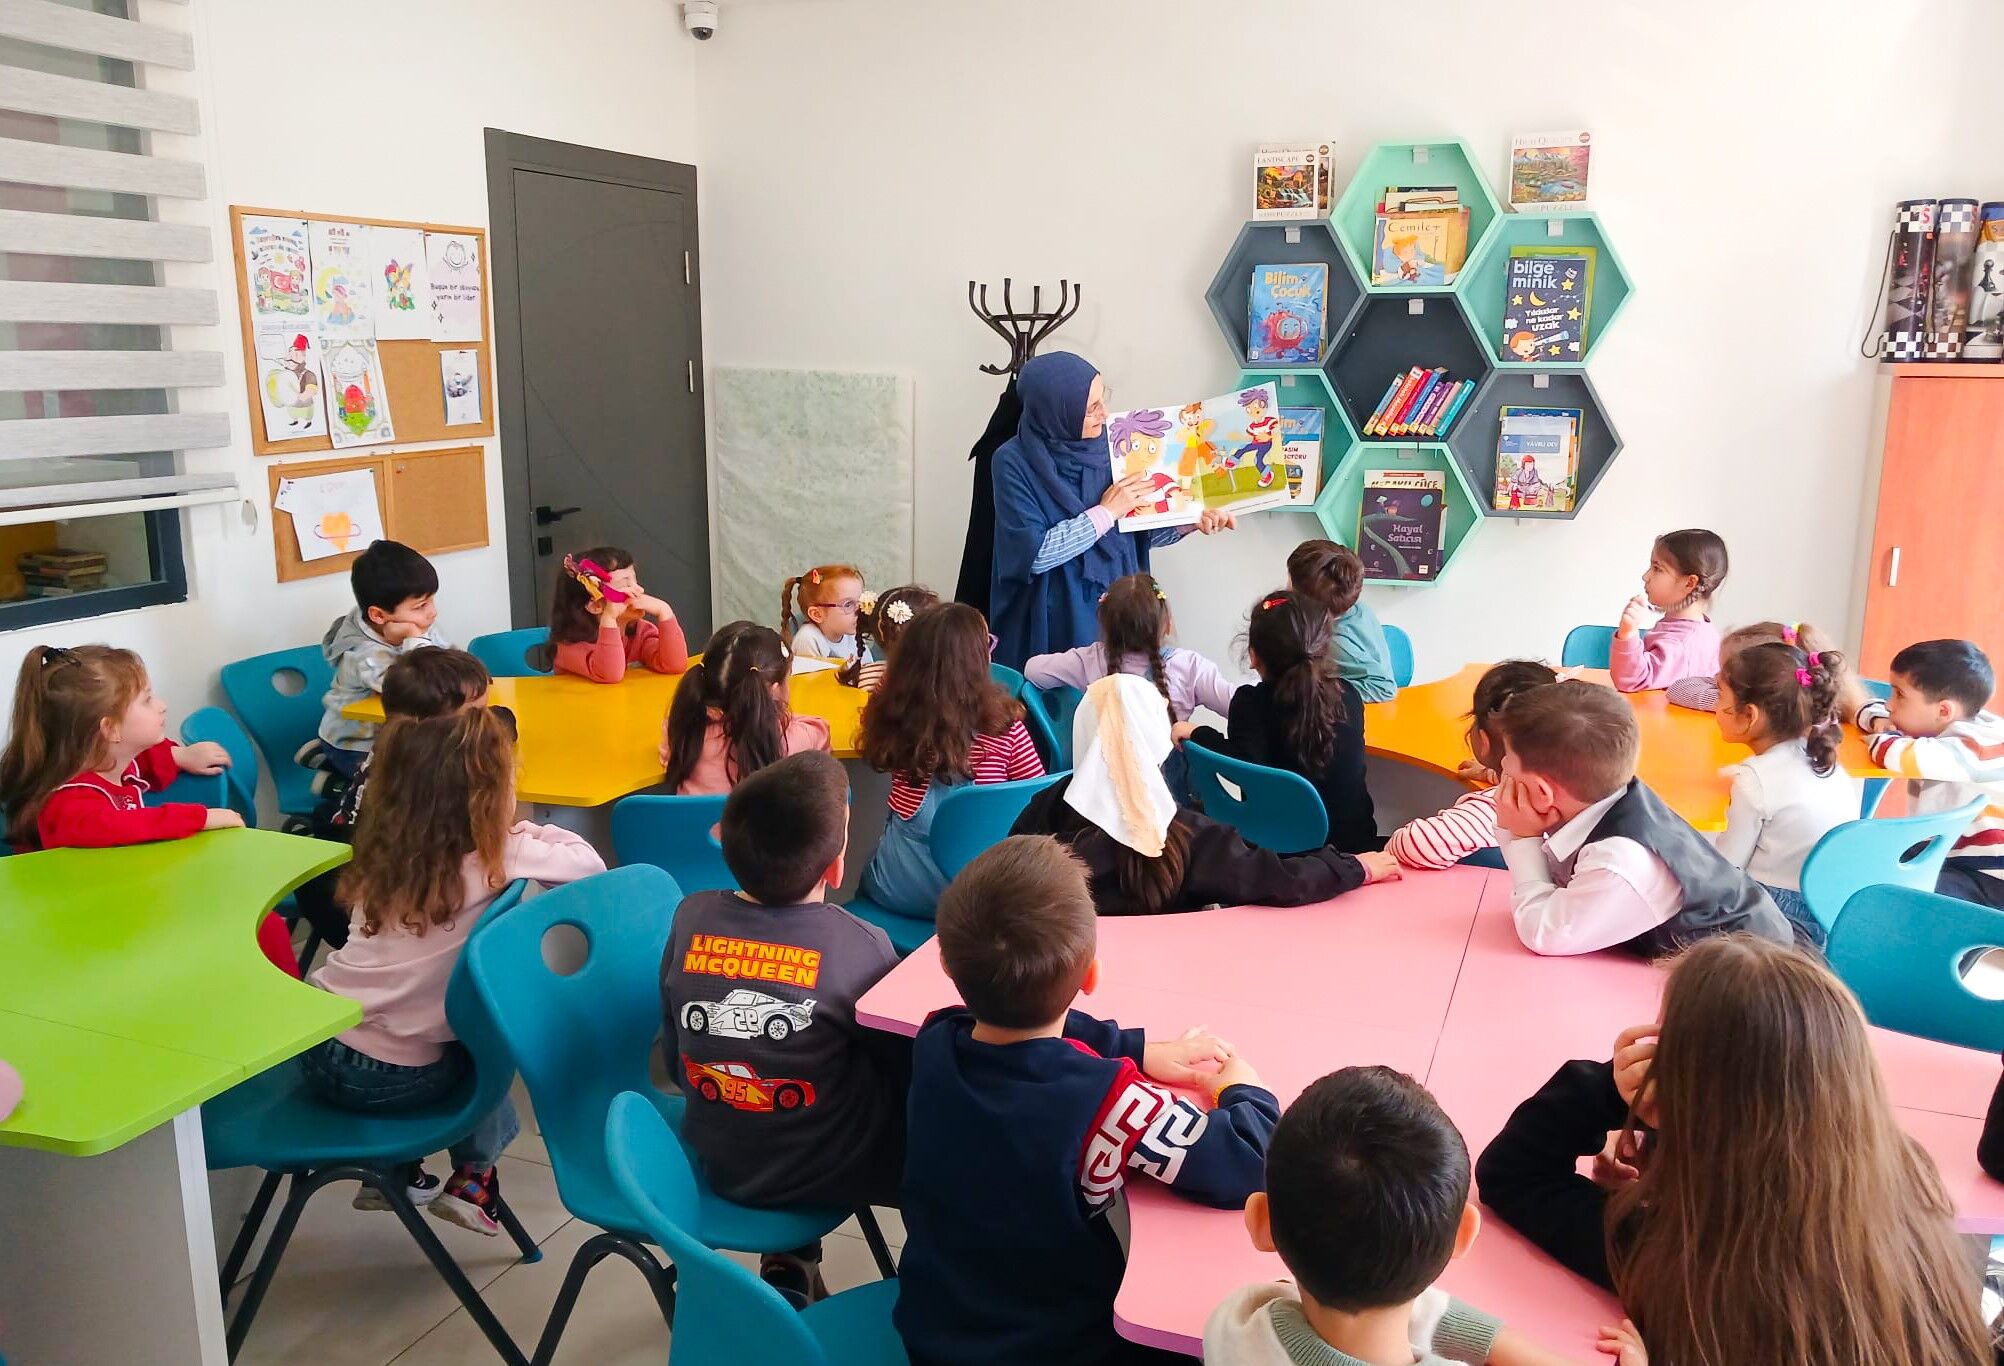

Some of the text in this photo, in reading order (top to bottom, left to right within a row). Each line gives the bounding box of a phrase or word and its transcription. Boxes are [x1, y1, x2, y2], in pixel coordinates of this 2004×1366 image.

[1513, 260, 1555, 278] bilge
[1265, 271, 1299, 285] Bilim
[1512, 275, 1558, 289] minik
[1525, 314, 1564, 325] ne kadar
[1531, 320, 1560, 332] uzak
[1393, 524, 1423, 535] Hayal
[691, 935, 819, 968] LIGHTNING
[724, 1079, 749, 1103] 95
